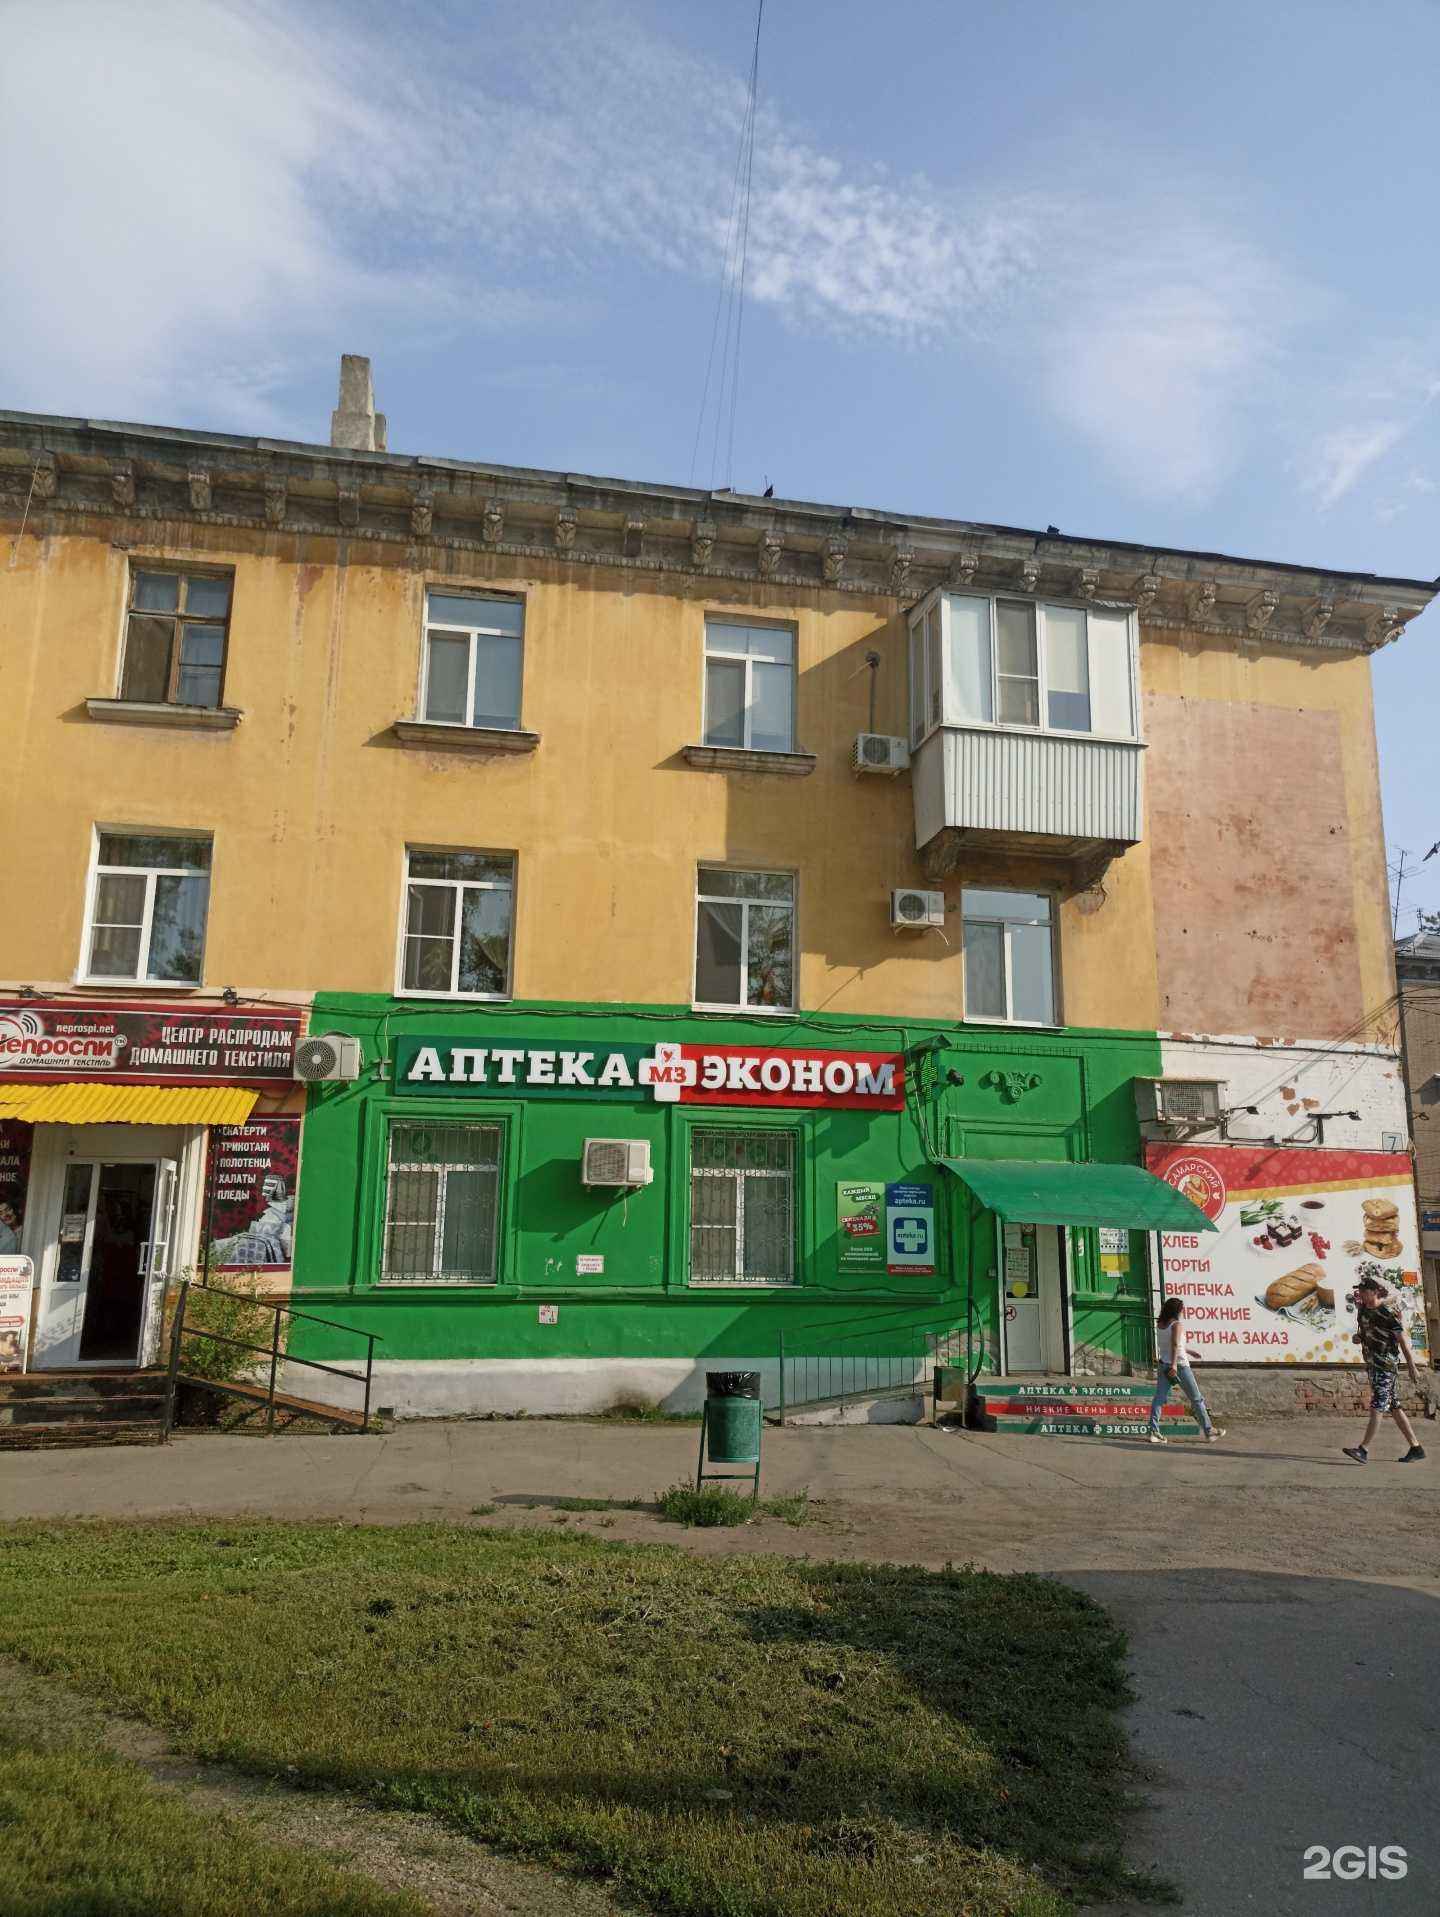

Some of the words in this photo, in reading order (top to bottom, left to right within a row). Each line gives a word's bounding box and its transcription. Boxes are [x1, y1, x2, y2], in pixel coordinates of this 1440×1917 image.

[56, 1023, 114, 1034] neprospi.net
[161, 1026, 203, 1044] ЦЕНТР
[209, 1028, 292, 1047] РАСПРОДАЖ
[129, 1047, 218, 1066] ДОМАШНЕГО
[224, 1050, 290, 1068] ТЕКСТИЛЯ
[408, 1047, 634, 1086] АПТЕКА
[701, 1055, 896, 1096] ЭКОНОМ
[222, 1126, 267, 1136] СКАТЕРТИ
[221, 1142, 270, 1152] ТРИКОТАЖ
[220, 1158, 271, 1168] ПОЛОТЕНЦА
[219, 1173, 256, 1184] ХАЛАТЫ
[217, 1190, 250, 1201] ПЛЕДЫ
[1163, 1236, 1199, 1249] ХЛЕБ
[1164, 1259, 1211, 1273] ТОРТЫ
[1165, 1283, 1235, 1297] ВЫПЕЧКА
[1219, 1332, 1239, 1344] НА
[1243, 1332, 1289, 1345] ЗАКАЗ
[1018, 1387, 1065, 1395] АПТЕКА
[1081, 1387, 1131, 1396] ЭКОНОМ
[1026, 1405, 1071, 1414] НИЗКИЕ
[1076, 1406, 1107, 1415] ЦЕНЫ
[1113, 1407, 1147, 1415] ЗДЕСЬ
[1040, 1424, 1089, 1433] АПТЕКА
[1106, 1426, 1151, 1434] ЭКОНО
